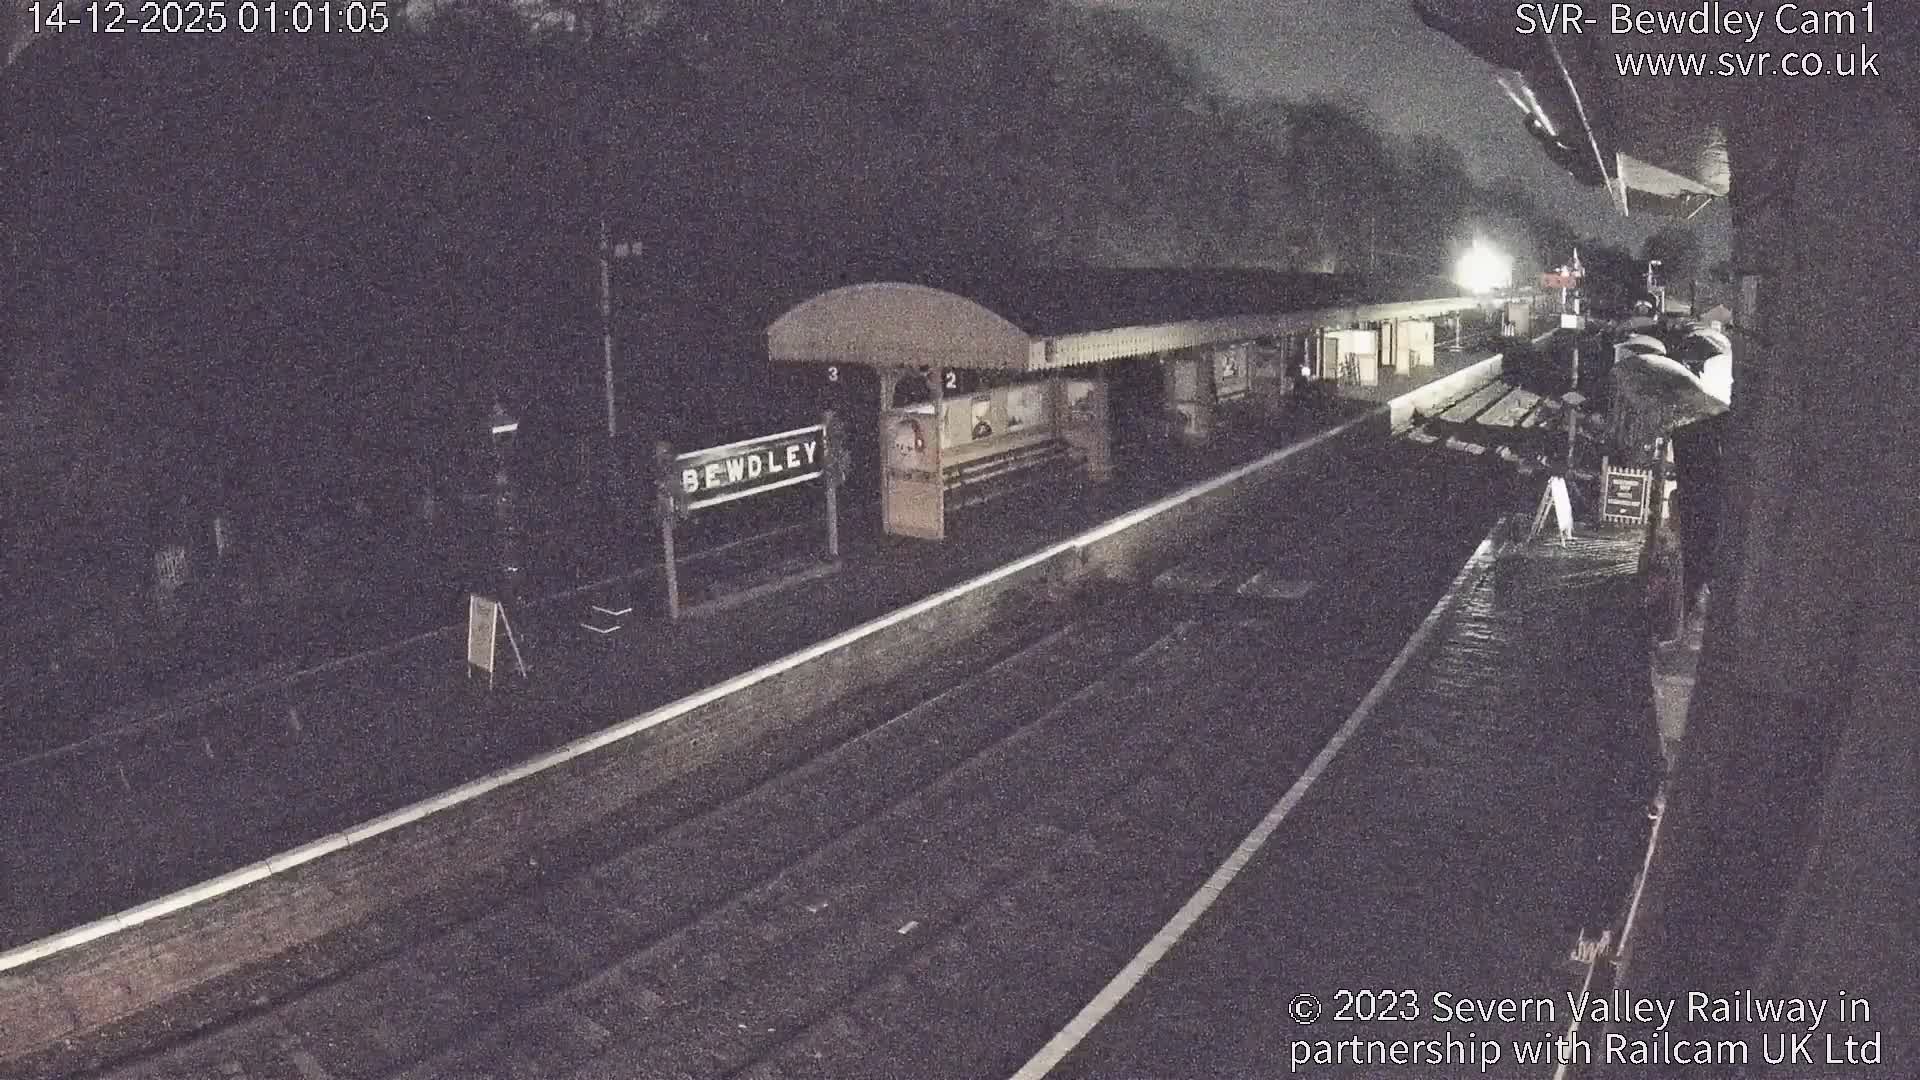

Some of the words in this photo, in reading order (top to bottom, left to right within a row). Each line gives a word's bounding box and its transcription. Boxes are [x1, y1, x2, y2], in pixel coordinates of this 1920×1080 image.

[827, 366, 839, 382] 3
[945, 371, 958, 389] 2
[681, 440, 817, 494] BEWDLEY
